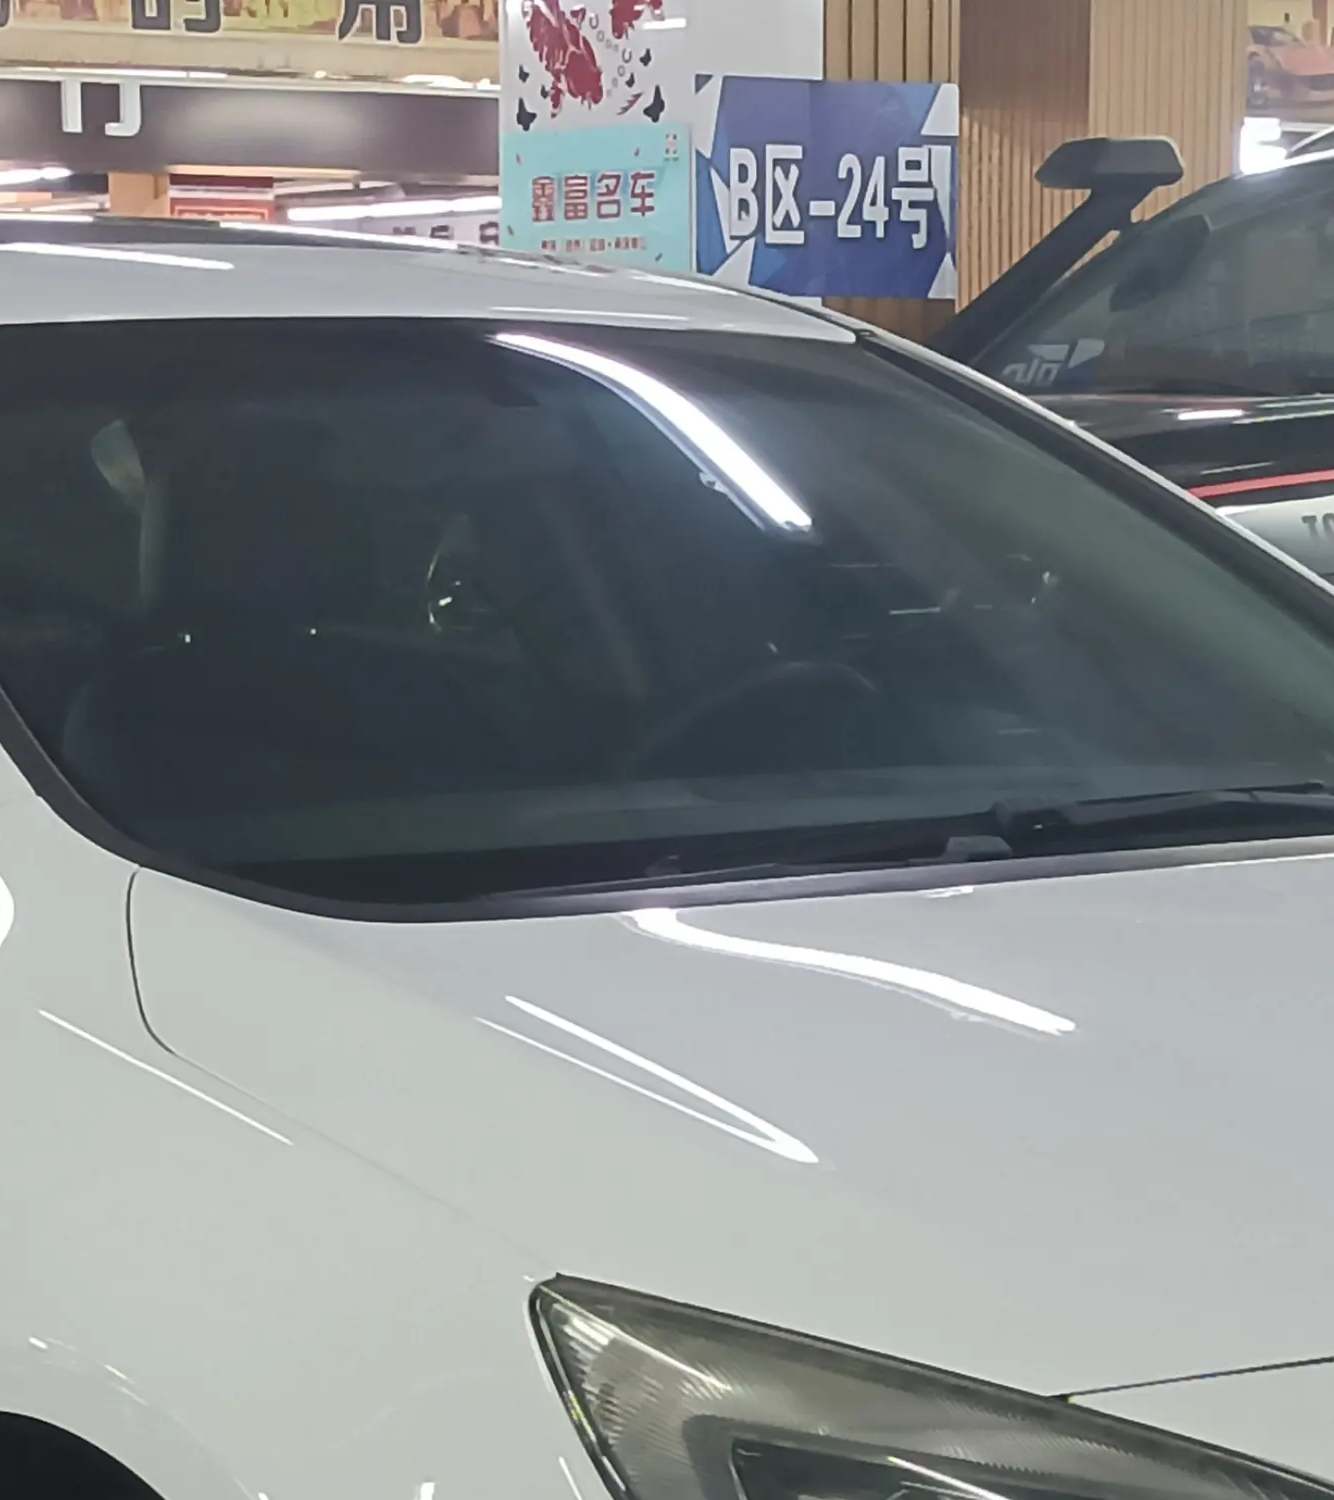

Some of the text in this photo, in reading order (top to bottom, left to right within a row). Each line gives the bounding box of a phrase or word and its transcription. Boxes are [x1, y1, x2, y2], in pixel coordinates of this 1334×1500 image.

[532, 171, 655, 223] 鑫富名车
[729, 144, 935, 249] B区-24号
